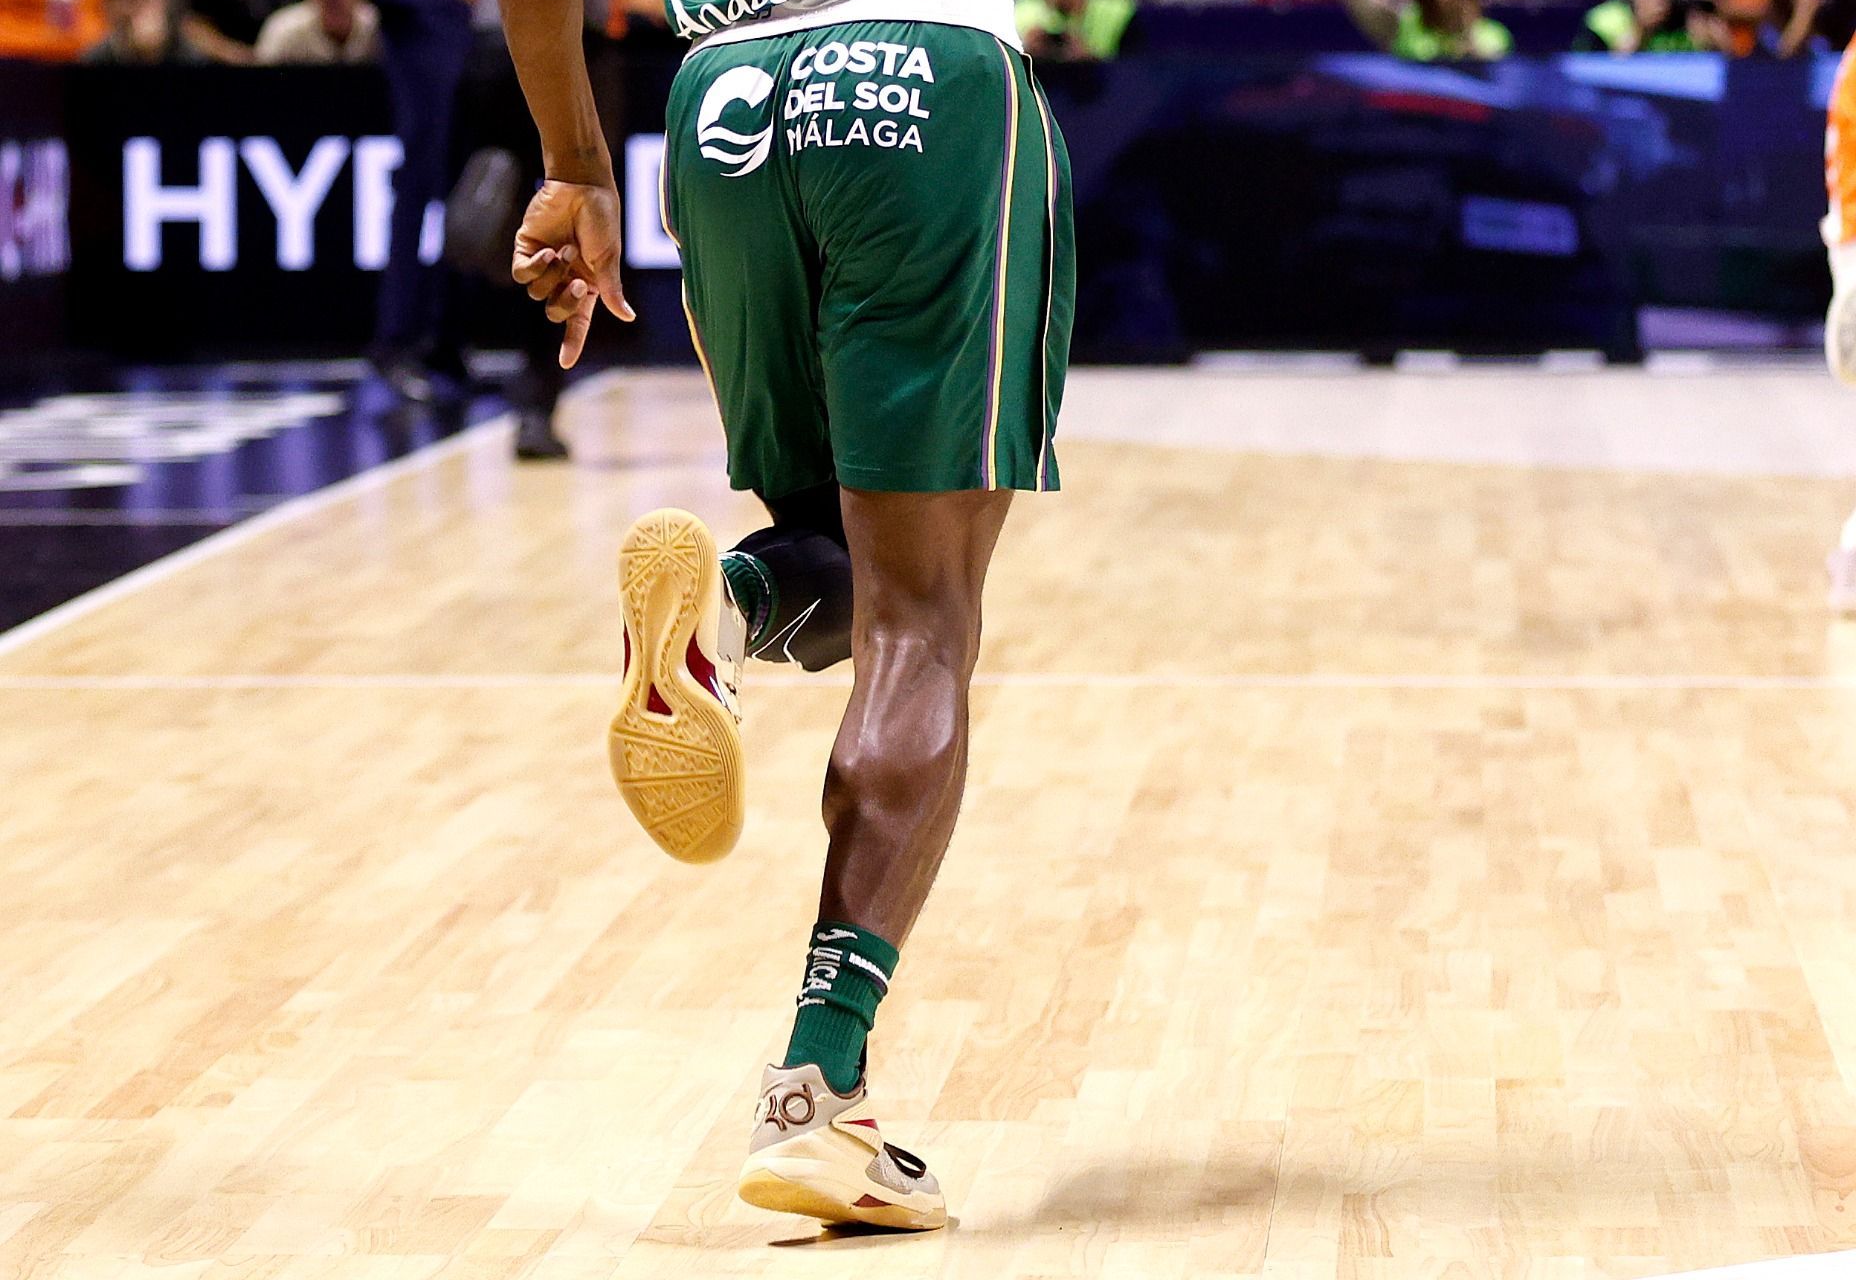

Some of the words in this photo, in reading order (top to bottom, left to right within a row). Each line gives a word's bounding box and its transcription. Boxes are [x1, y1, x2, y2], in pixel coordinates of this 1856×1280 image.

[791, 41, 935, 83] COSTA
[784, 82, 845, 120] DEL
[852, 81, 930, 119] SOL
[786, 113, 923, 156] MÁLAGA
